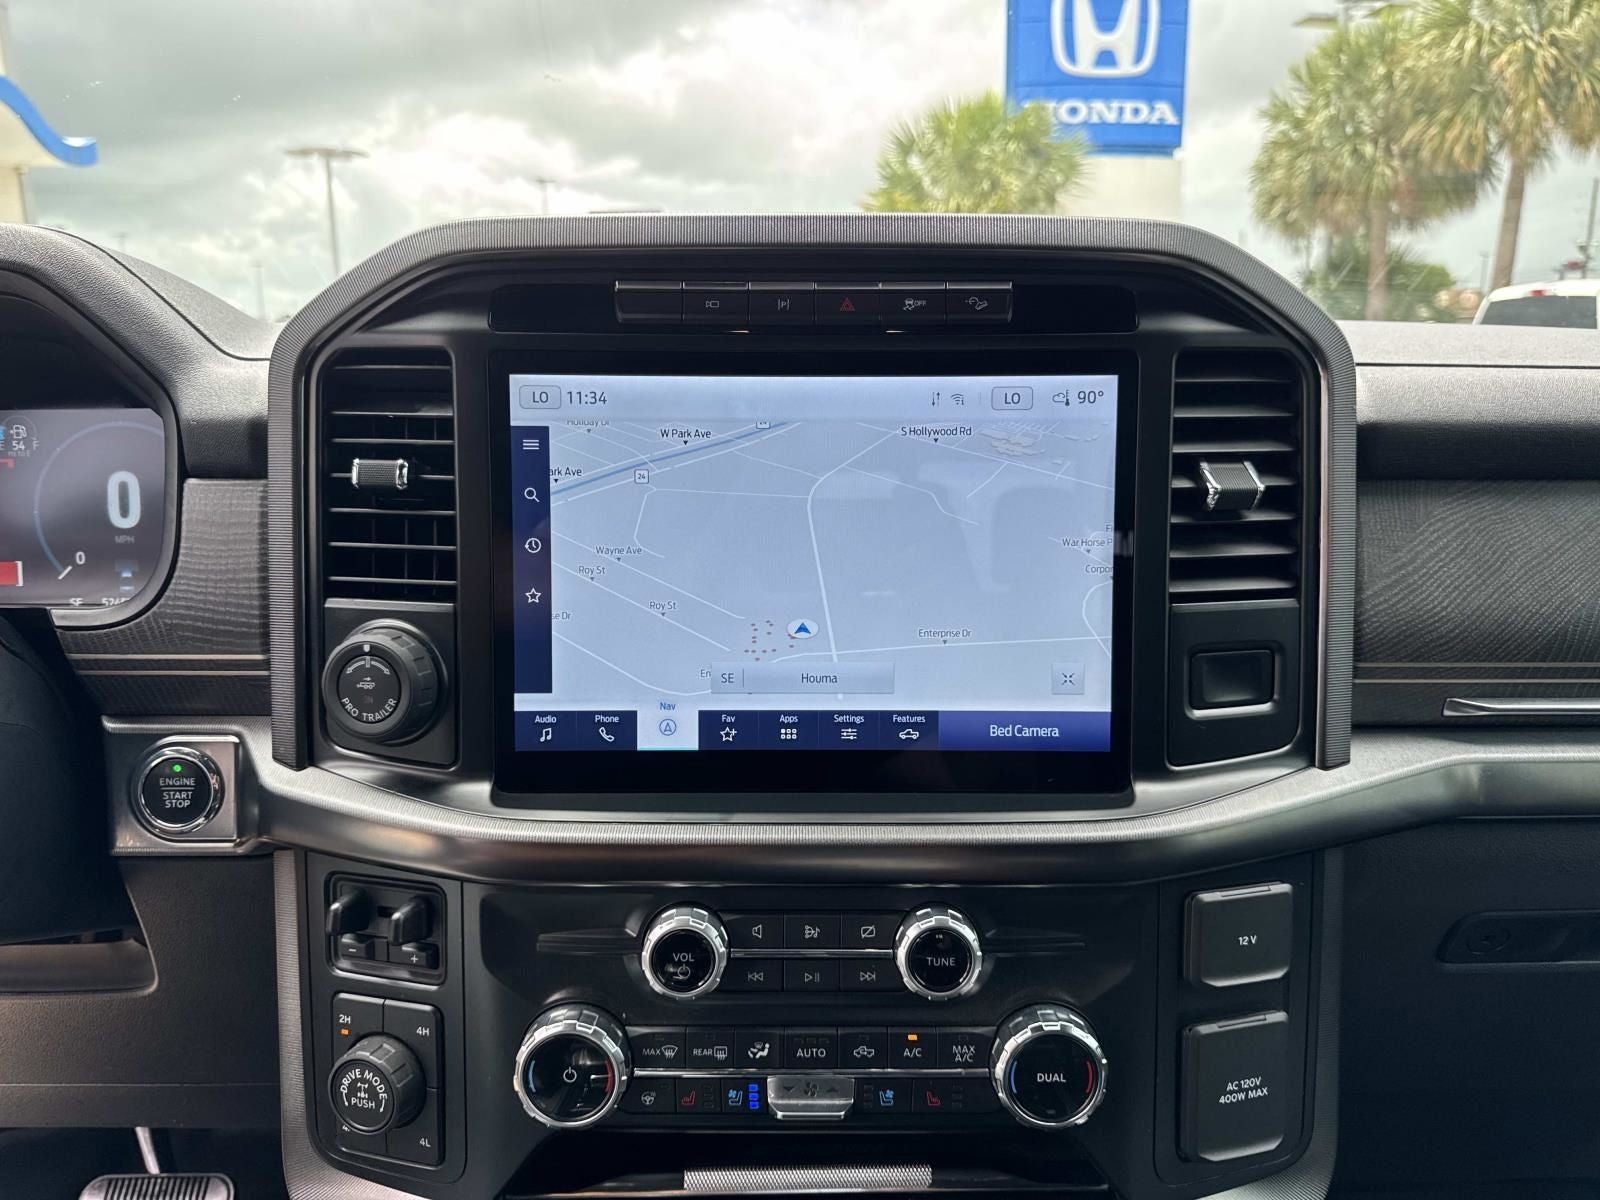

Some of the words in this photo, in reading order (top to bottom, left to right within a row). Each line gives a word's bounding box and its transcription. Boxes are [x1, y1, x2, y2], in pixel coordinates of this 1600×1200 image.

[1022, 99, 1180, 125] ONDA
[532, 391, 549, 404] LO
[566, 391, 608, 405] 11:34
[1004, 392, 1021, 405] LO
[1077, 390, 1104, 404] 90°
[660, 429, 671, 438] W
[673, 429, 692, 438] Park
[694, 429, 712, 438] Ave
[901, 427, 907, 436] S
[909, 426, 958, 438] Hollywood
[960, 426, 972, 436] Rd
[12, 440, 25, 450] 54
[565, 467, 582, 476] Ave
[107, 470, 141, 529] 0
[115, 535, 135, 544] MPH
[1062, 537, 1079, 546] War
[1081, 538, 1105, 546] Horse
[596, 546, 624, 556] Wayne
[626, 546, 642, 555] Ave
[75, 551, 86, 565] 0
[578, 566, 595, 576] Roy
[596, 566, 605, 574] St
[650, 601, 666, 611] Roy
[667, 601, 676, 610] St
[561, 611, 571, 620] Dr
[918, 629, 960, 639] Enterprise
[961, 629, 971, 638] Dr
[721, 673, 734, 683] SE
[801, 673, 838, 683] Houma
[341, 697, 359, 717] PRO
[362, 698, 397, 721] TRAILER
[660, 702, 676, 711] Nav
[535, 714, 557, 724] Audio
[595, 714, 619, 723] Phone
[722, 714, 736, 723] Fav
[780, 714, 799, 725] Apps
[833, 714, 864, 725] Settings
[893, 714, 925, 723] Features
[990, 725, 1012, 737] Bed
[1014, 725, 1059, 738] Camera
[160, 777, 196, 786] ENGINE
[163, 791, 193, 800] START
[165, 800, 191, 808] STOP
[1238, 936, 1249, 945] 12
[1250, 935, 1257, 944] V
[673, 952, 695, 963] VOL
[926, 957, 956, 967] TUNE
[339, 1014, 351, 1024] 2H
[416, 1027, 430, 1036] 4H
[642, 1048, 661, 1056] MAX
[693, 1048, 713, 1056] REAR
[796, 1048, 826, 1058] AUTO
[903, 1047, 922, 1057] A/C
[952, 1045, 975, 1054] MAX
[955, 1053, 974, 1063] A/C
[1037, 1073, 1066, 1083] DUAL
[340, 1068, 362, 1093] DRIVE
[363, 1069, 388, 1100] MODE
[1226, 1080, 1240, 1091] AC
[1240, 1077, 1262, 1089] 120V
[1219, 1091, 1246, 1104] 400W
[1247, 1086, 1268, 1100] MAX
[351, 1097, 375, 1109] PUSH
[419, 1137, 431, 1147] 4L
